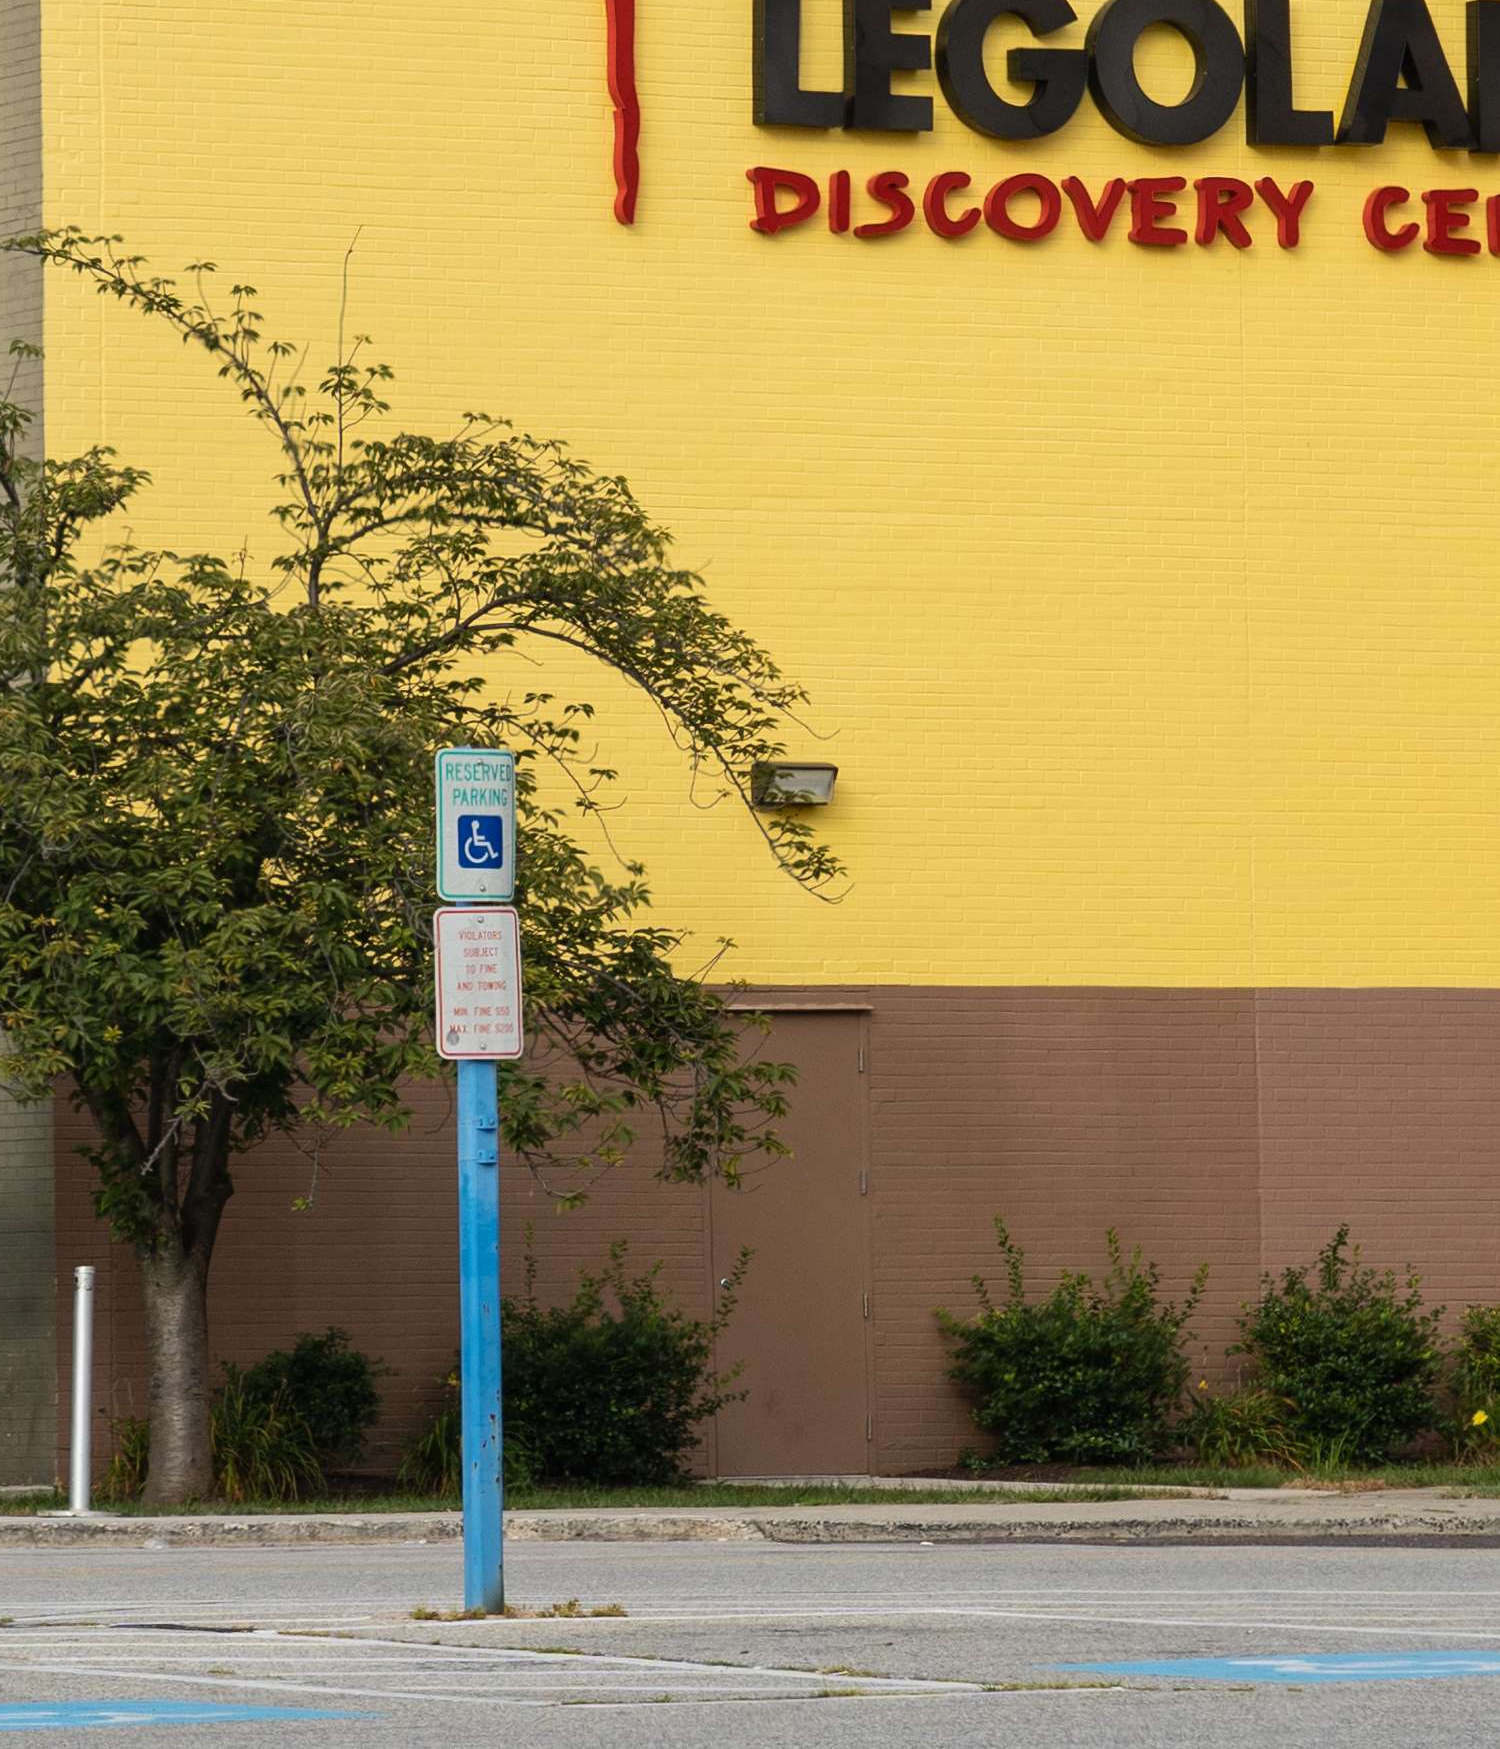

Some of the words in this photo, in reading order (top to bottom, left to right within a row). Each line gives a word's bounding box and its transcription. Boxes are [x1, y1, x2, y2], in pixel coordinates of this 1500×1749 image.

[745, 165, 1315, 251] DISCOVERY
[445, 763, 511, 782] RESERVED
[452, 789, 508, 806] PARKING
[458, 931, 502, 940] VIOLATORS
[463, 947, 498, 957] SUBJECT
[466, 964, 476, 973] TO
[479, 963, 497, 973] FINE
[457, 981, 473, 991] AND
[478, 981, 506, 991] TOWING
[474, 1007, 492, 1017] FINE
[473, 1024, 492, 1034] FINE
